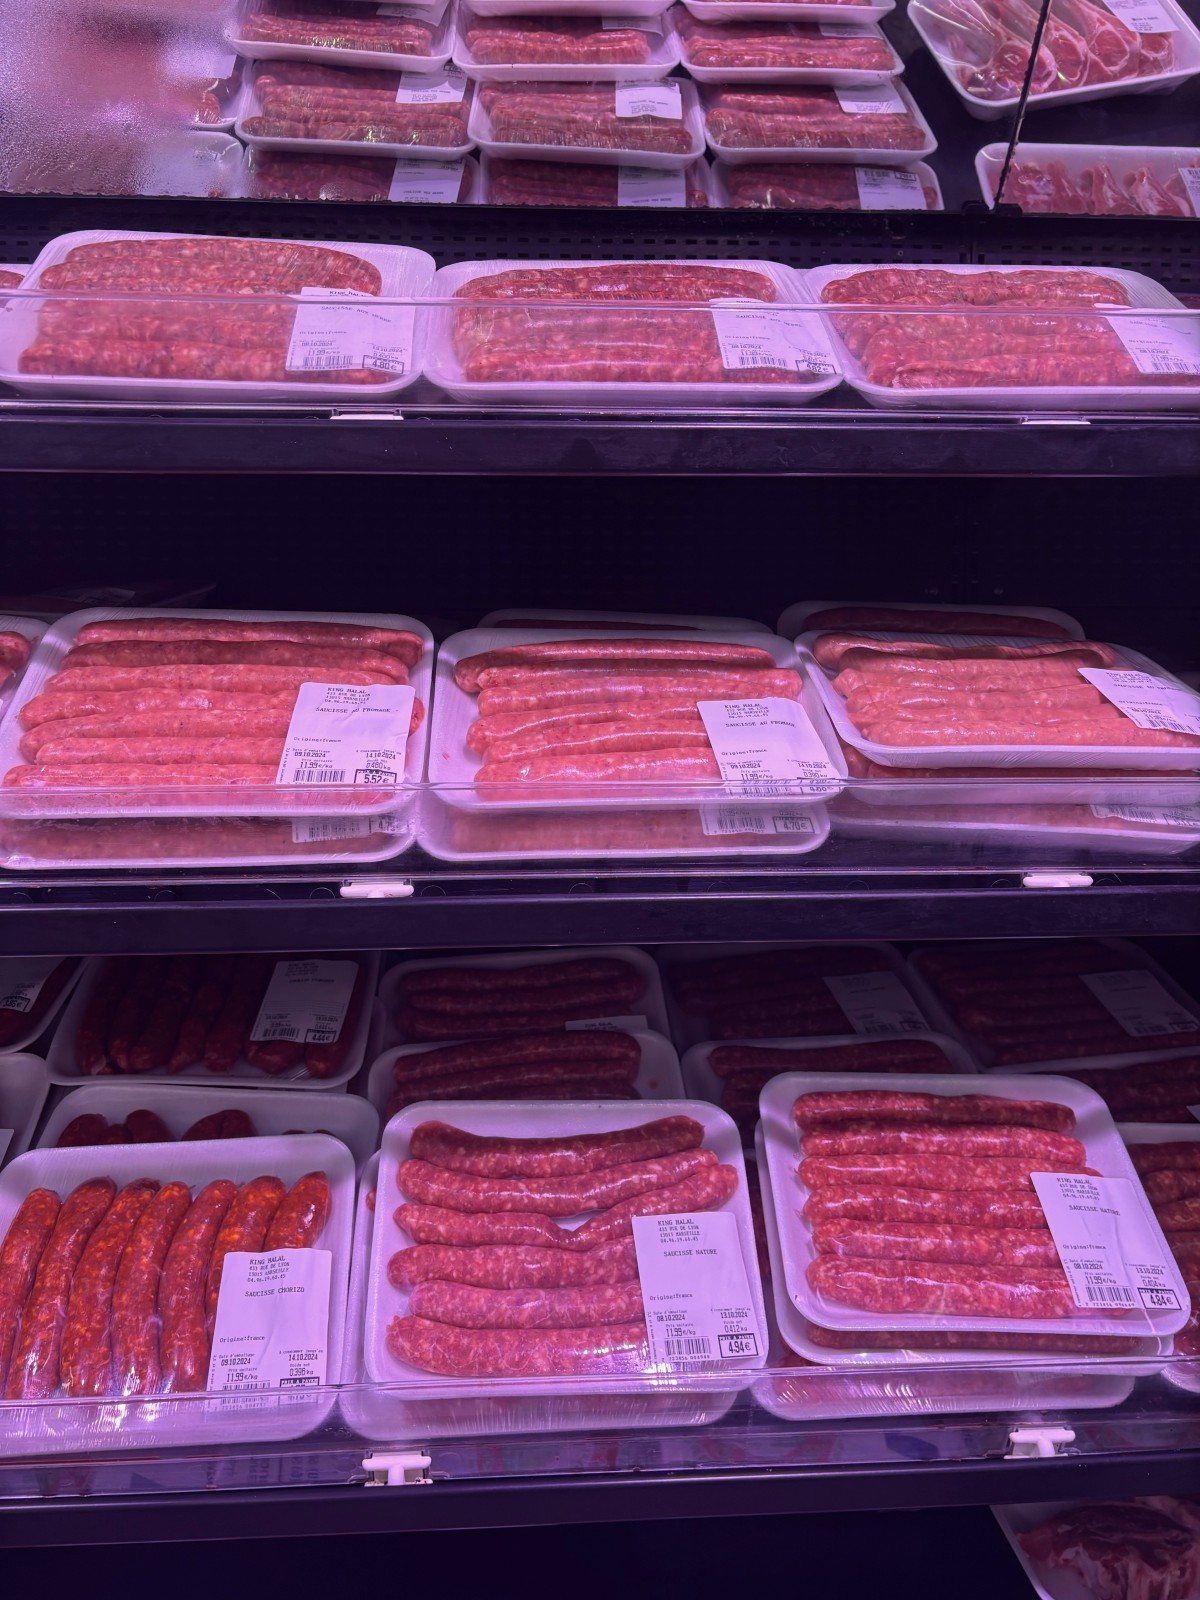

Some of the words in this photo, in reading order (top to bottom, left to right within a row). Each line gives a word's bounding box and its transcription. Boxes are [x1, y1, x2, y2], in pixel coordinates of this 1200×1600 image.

[364, 774, 390, 784] 5.52€
[1099, 1207, 1121, 1216] NATURE
[695, 1248, 718, 1256] NATURE
[268, 1256, 286, 1264] HALAL
[245, 1288, 275, 1297] SAUCISSE
[278, 1286, 305, 1294] CHORIZO
[650, 1293, 693, 1301] Origine:france
[1150, 1294, 1174, 1306] 4.84€
[656, 1314, 686, 1322] 08.10.2024
[720, 1311, 748, 1319] 13.10.2024
[666, 1327, 696, 1338] 11.99€/kg
[220, 1335, 266, 1343] Origine:france
[729, 1340, 751, 1353] 4.94€
[289, 1353, 318, 1362] 14.10.2024
[221, 1358, 251, 1367] 09.10.2024
[226, 1372, 258, 1382] 11.99€/kg
